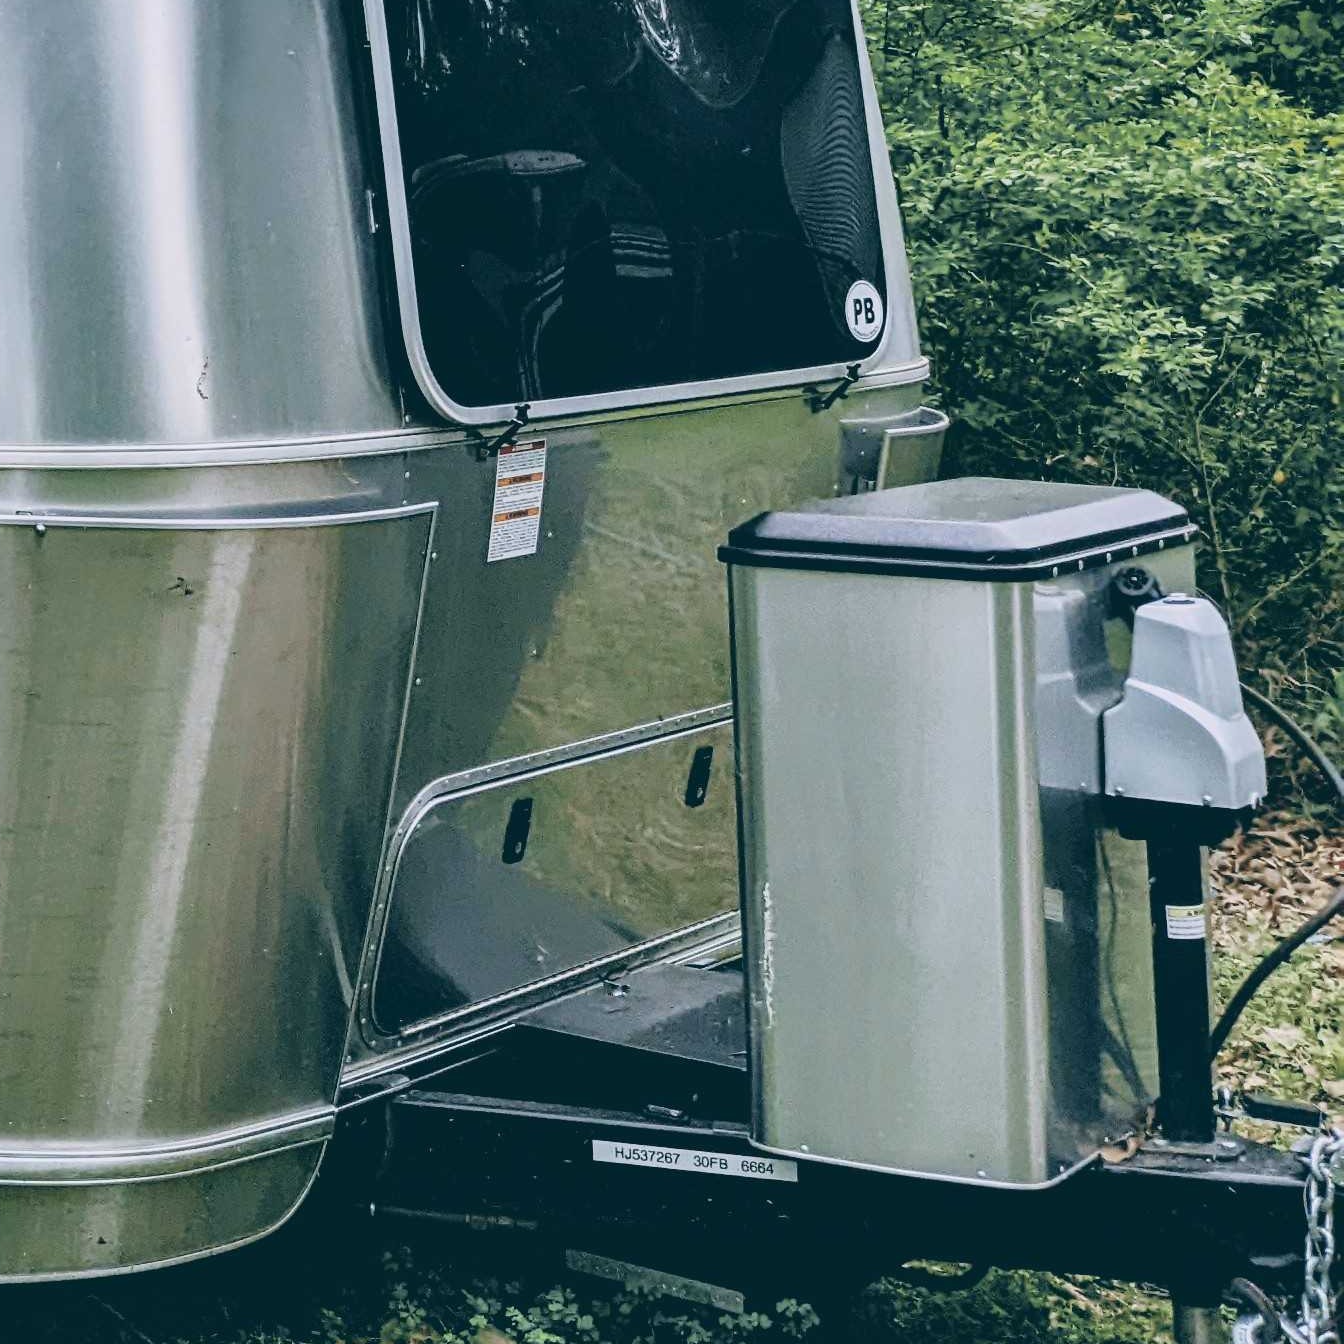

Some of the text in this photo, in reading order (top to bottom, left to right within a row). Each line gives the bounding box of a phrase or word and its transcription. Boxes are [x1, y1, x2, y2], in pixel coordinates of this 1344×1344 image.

[853, 297, 875, 325] PB
[615, 1146, 774, 1175] HJ537267 30FB 6664
